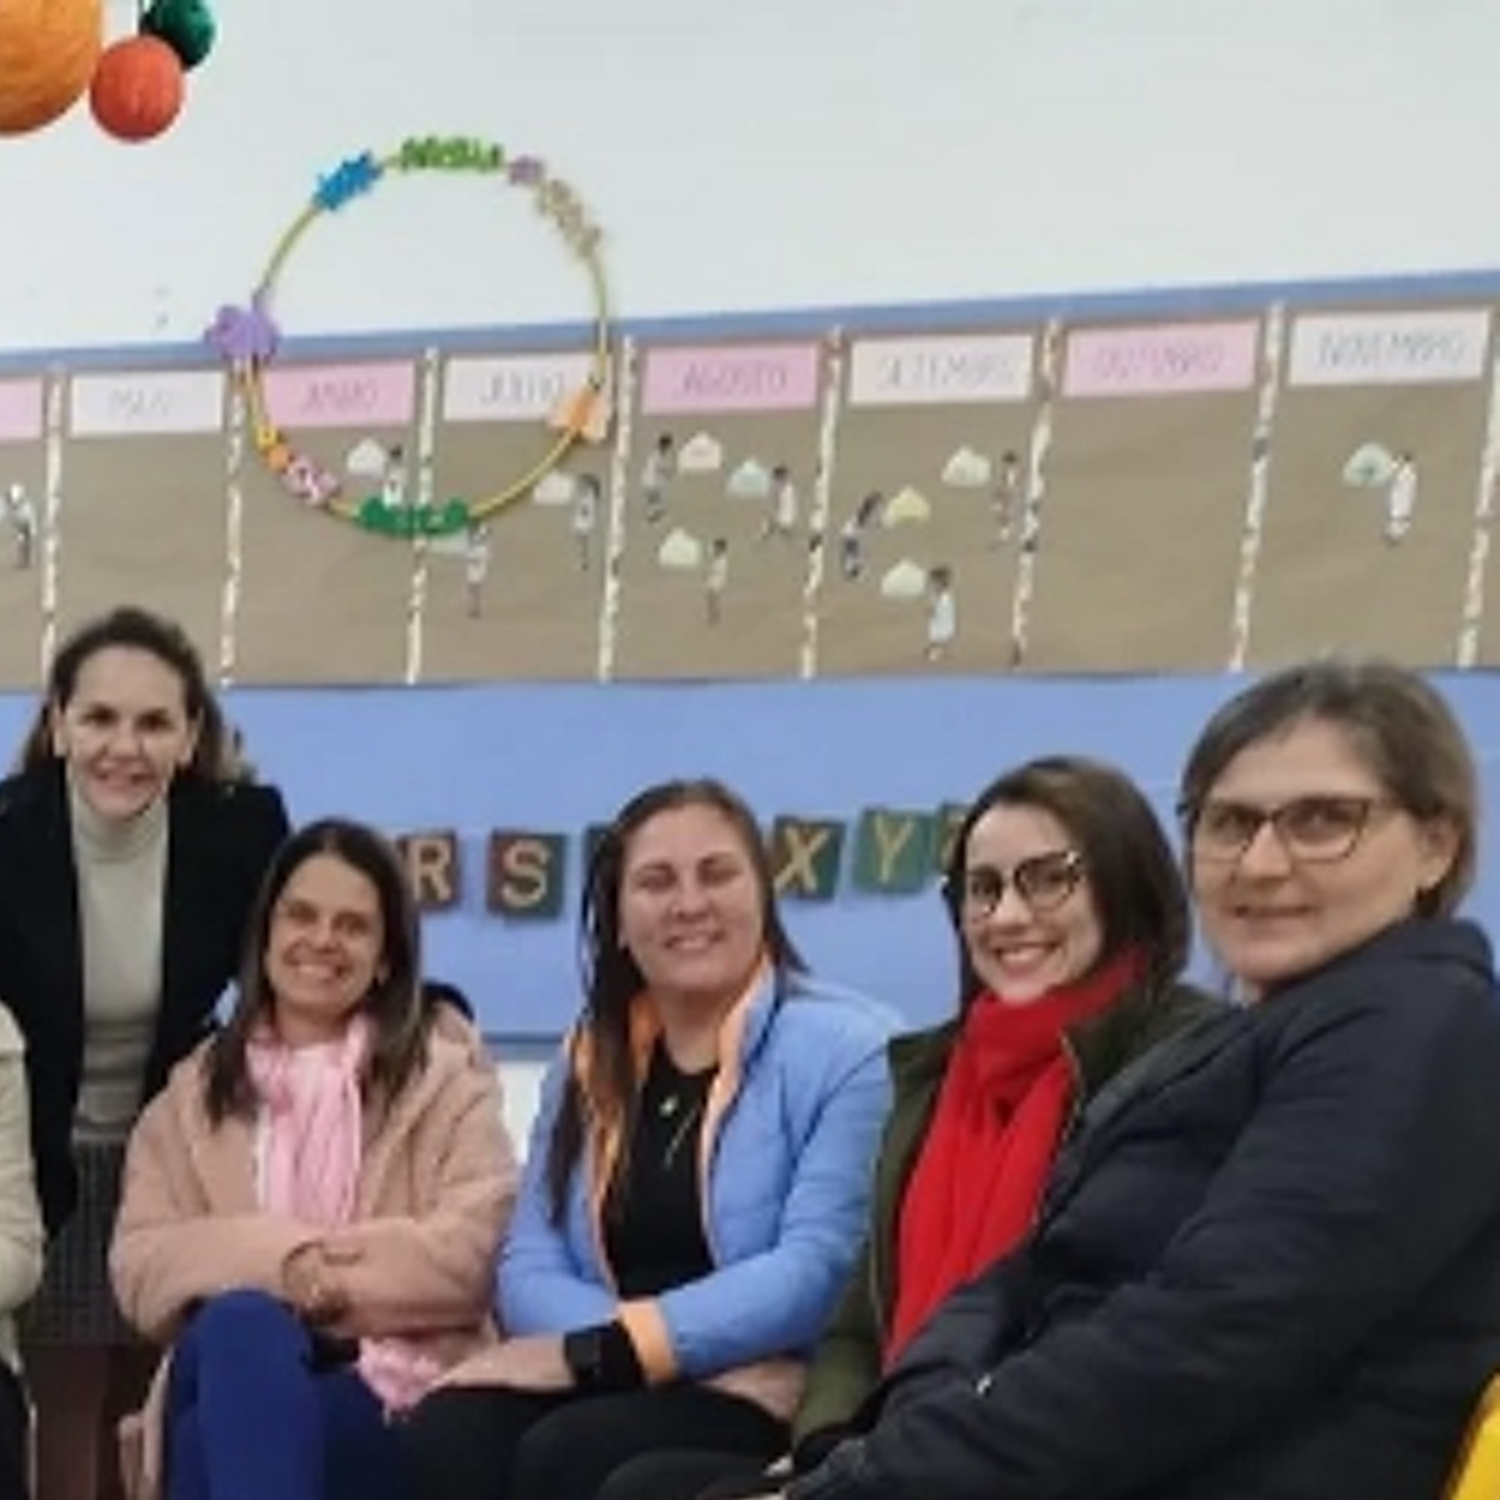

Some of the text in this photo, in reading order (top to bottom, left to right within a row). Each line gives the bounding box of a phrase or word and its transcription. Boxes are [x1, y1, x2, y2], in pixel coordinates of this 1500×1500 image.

[407, 838, 549, 909] R S
[775, 826, 829, 893] X
[874, 815, 914, 883] Y
